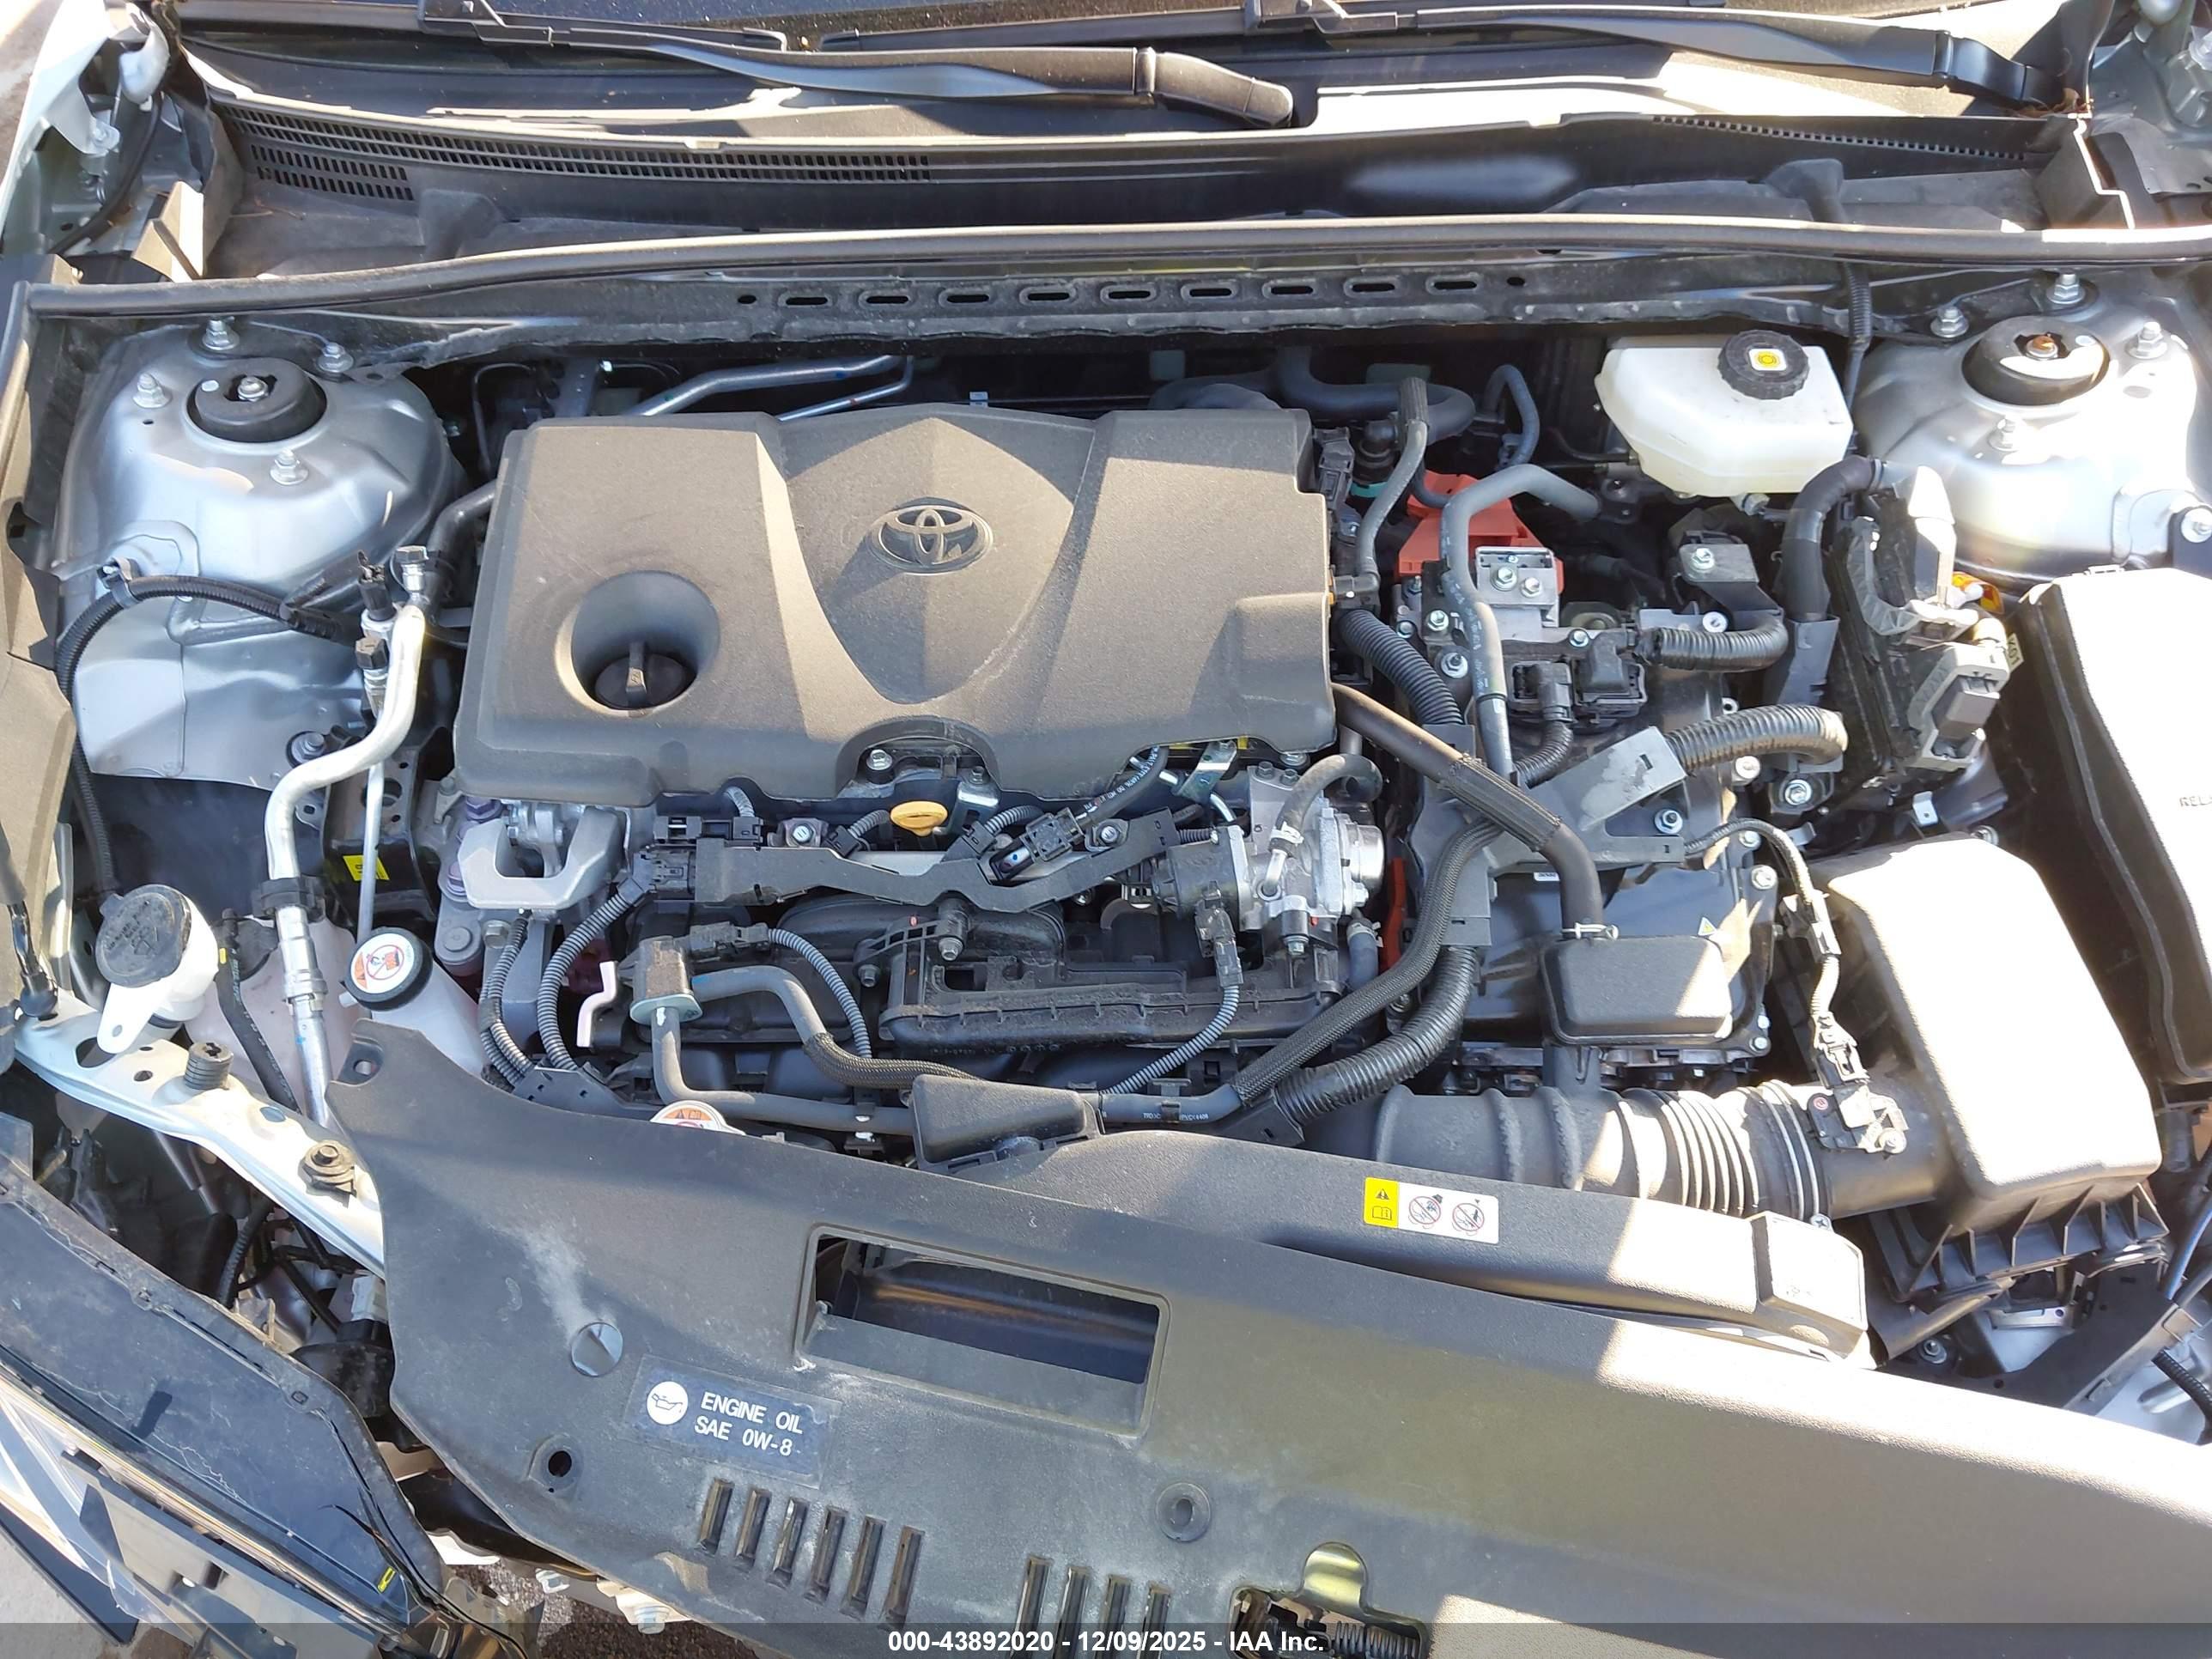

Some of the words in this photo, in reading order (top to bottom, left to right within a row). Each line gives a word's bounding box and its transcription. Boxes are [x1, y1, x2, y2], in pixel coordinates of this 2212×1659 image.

[2179, 795, 2212, 807] REL
[700, 1391, 767, 1424] ENGINE
[775, 1411, 803, 1435] OIL
[694, 1415, 732, 1441] SAE
[742, 1428, 793, 1456] 0W-8
